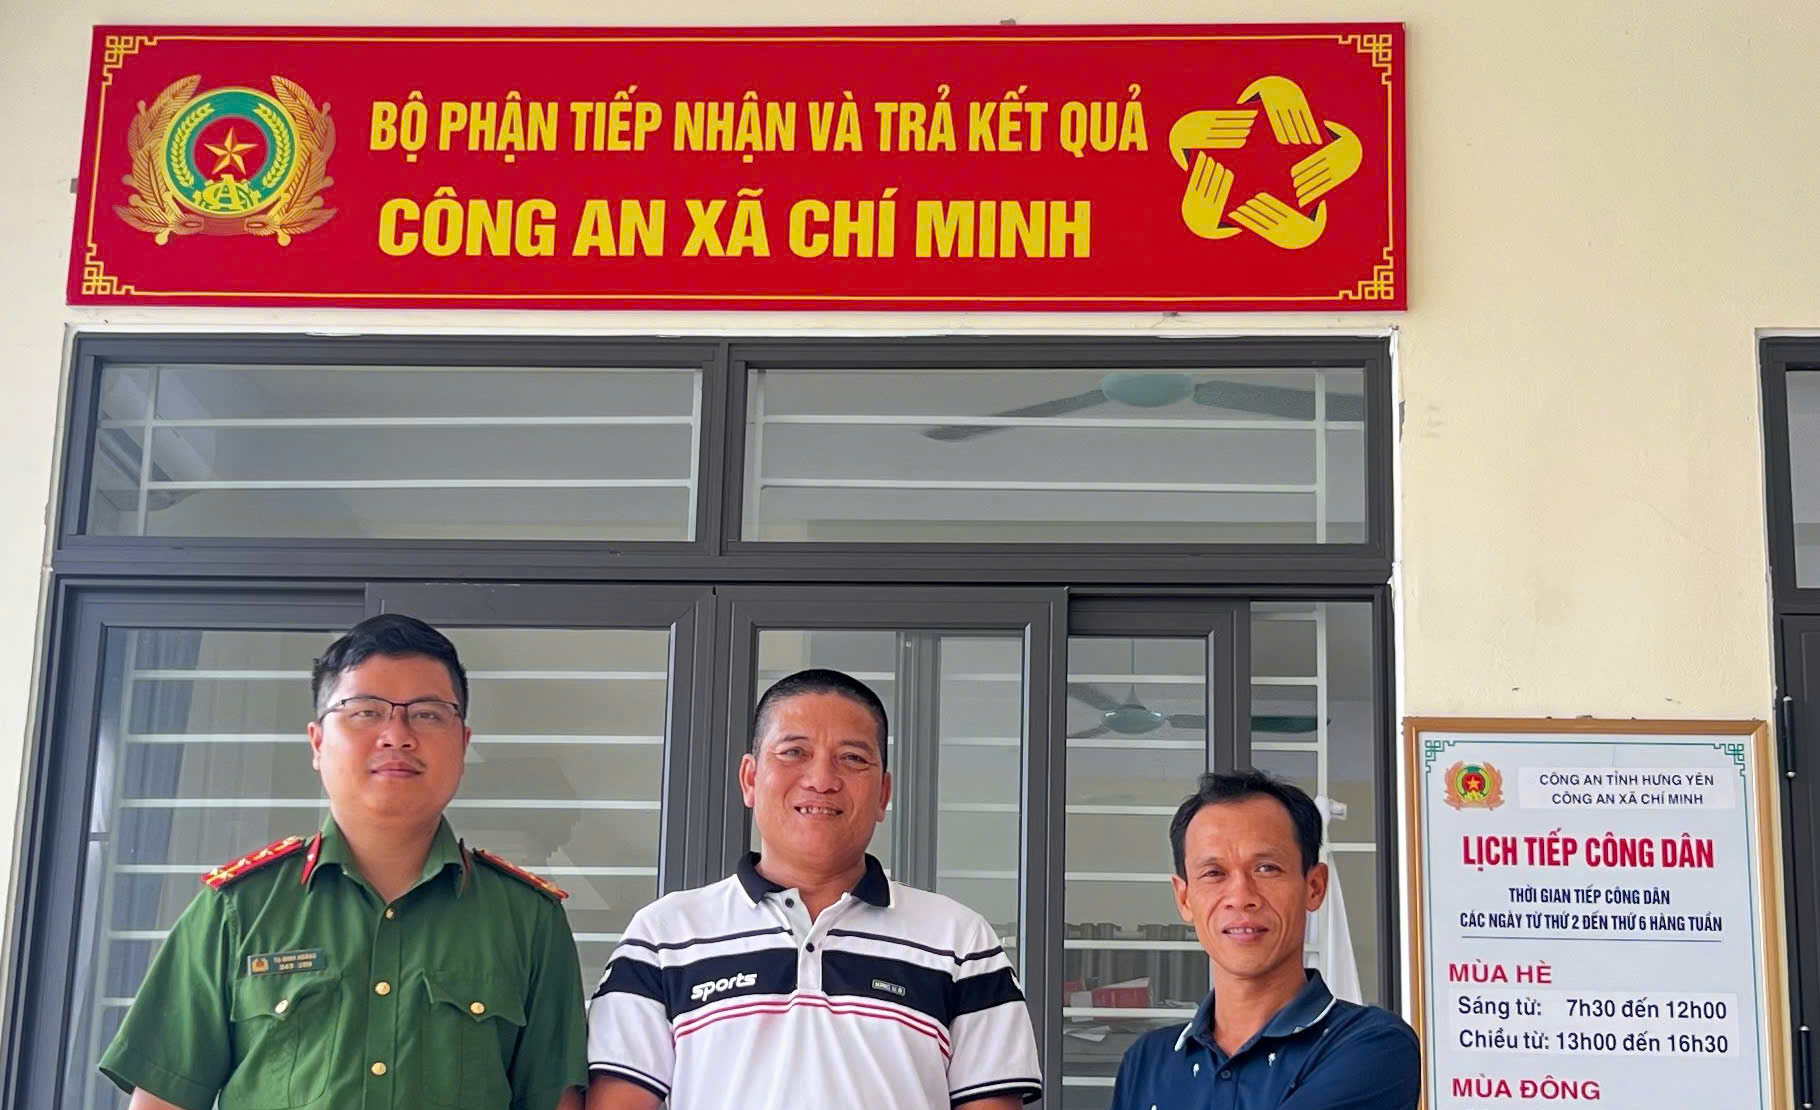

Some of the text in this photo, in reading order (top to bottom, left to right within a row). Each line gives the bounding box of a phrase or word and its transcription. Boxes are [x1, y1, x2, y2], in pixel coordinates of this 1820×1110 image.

[369, 83, 1148, 163] BỘ PHẬN TIẾP NHẬN VÀ TRẢ KẾT QUẢ
[378, 186, 1091, 258] CÔNG AN XÃ CHÍ MINH
[1539, 770, 1715, 786] CÔNG AN TỈNH HƯNG YÊN
[1551, 790, 1704, 805] CÔNG AN XÃ CHÍ MINH
[1462, 827, 1715, 872] LỊCH TIẾP CÔNG DÂN
[1508, 883, 1671, 905] THỜI GIAN TIẾP CÔNG DÂN
[1459, 909, 1723, 932] CÁC NGÀY TỪ THỨ 2 ĐẾN THỨ 6 HÀNG TUẦN
[1448, 958, 1553, 985] MÙA HÈ
[690, 972, 758, 1002] sports
[1458, 995, 1727, 1020] Sáng từ: 7h30 đến 12h00
[1459, 1027, 1728, 1054] Chiều từ: 13h00 đến 16h30
[1452, 1073, 1601, 1101] MÙA ĐÔNG
